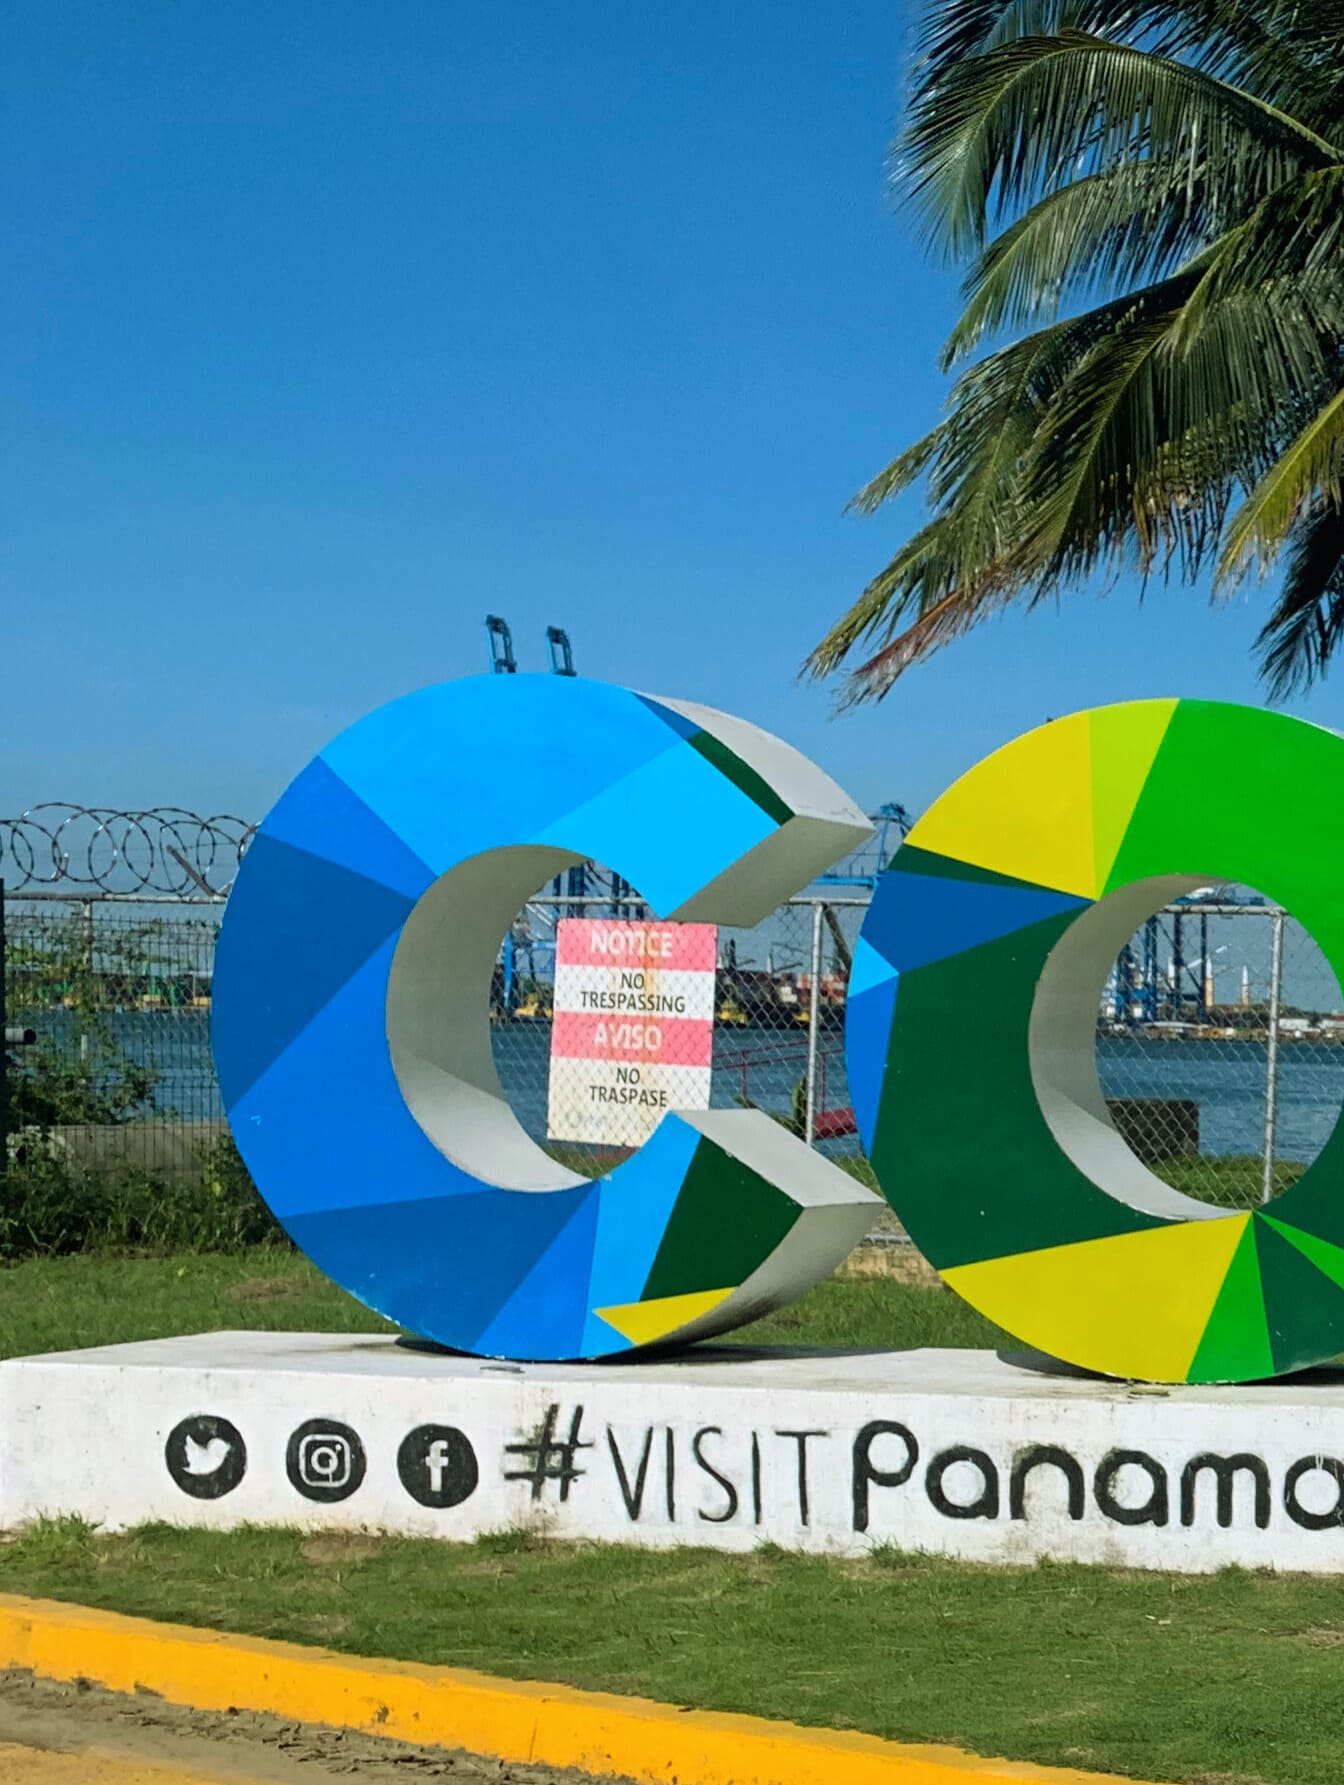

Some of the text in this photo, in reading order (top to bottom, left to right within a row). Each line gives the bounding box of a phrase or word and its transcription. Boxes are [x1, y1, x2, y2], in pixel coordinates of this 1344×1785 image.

[590, 928, 674, 958] NOTICE
[620, 972, 645, 989] NO
[580, 991, 686, 1013] TRESPASSING
[593, 1022, 663, 1051] AVISO
[616, 1067, 641, 1084] NO
[590, 1085, 668, 1108] TRASPASE
